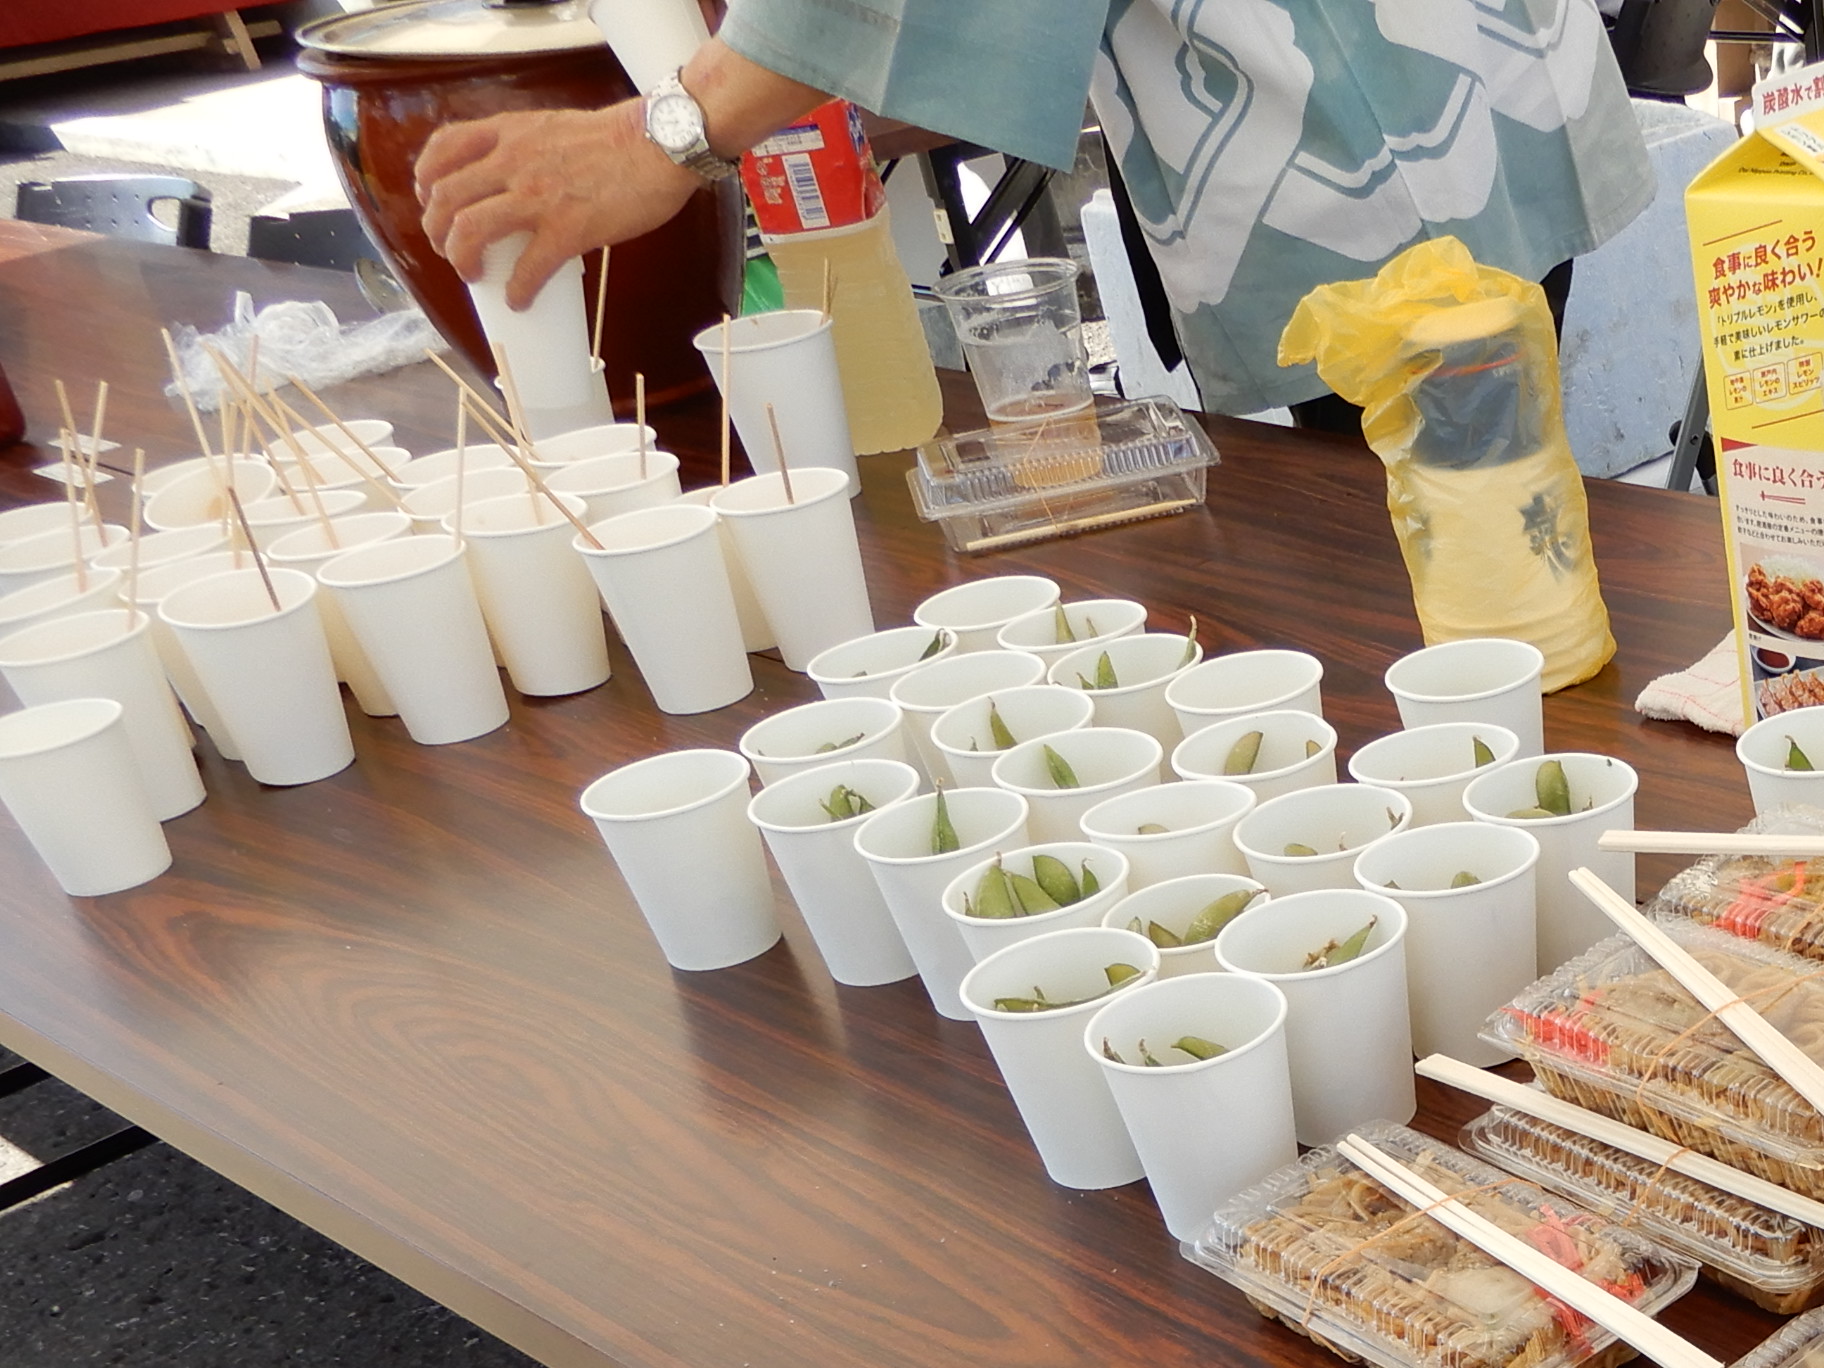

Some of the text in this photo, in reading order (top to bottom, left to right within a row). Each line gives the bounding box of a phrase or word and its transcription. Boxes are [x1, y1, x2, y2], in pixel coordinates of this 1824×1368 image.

[1712, 229, 1817, 281] 食事に良く合う
[1708, 257, 1824, 310] 爽やかな味わい!
